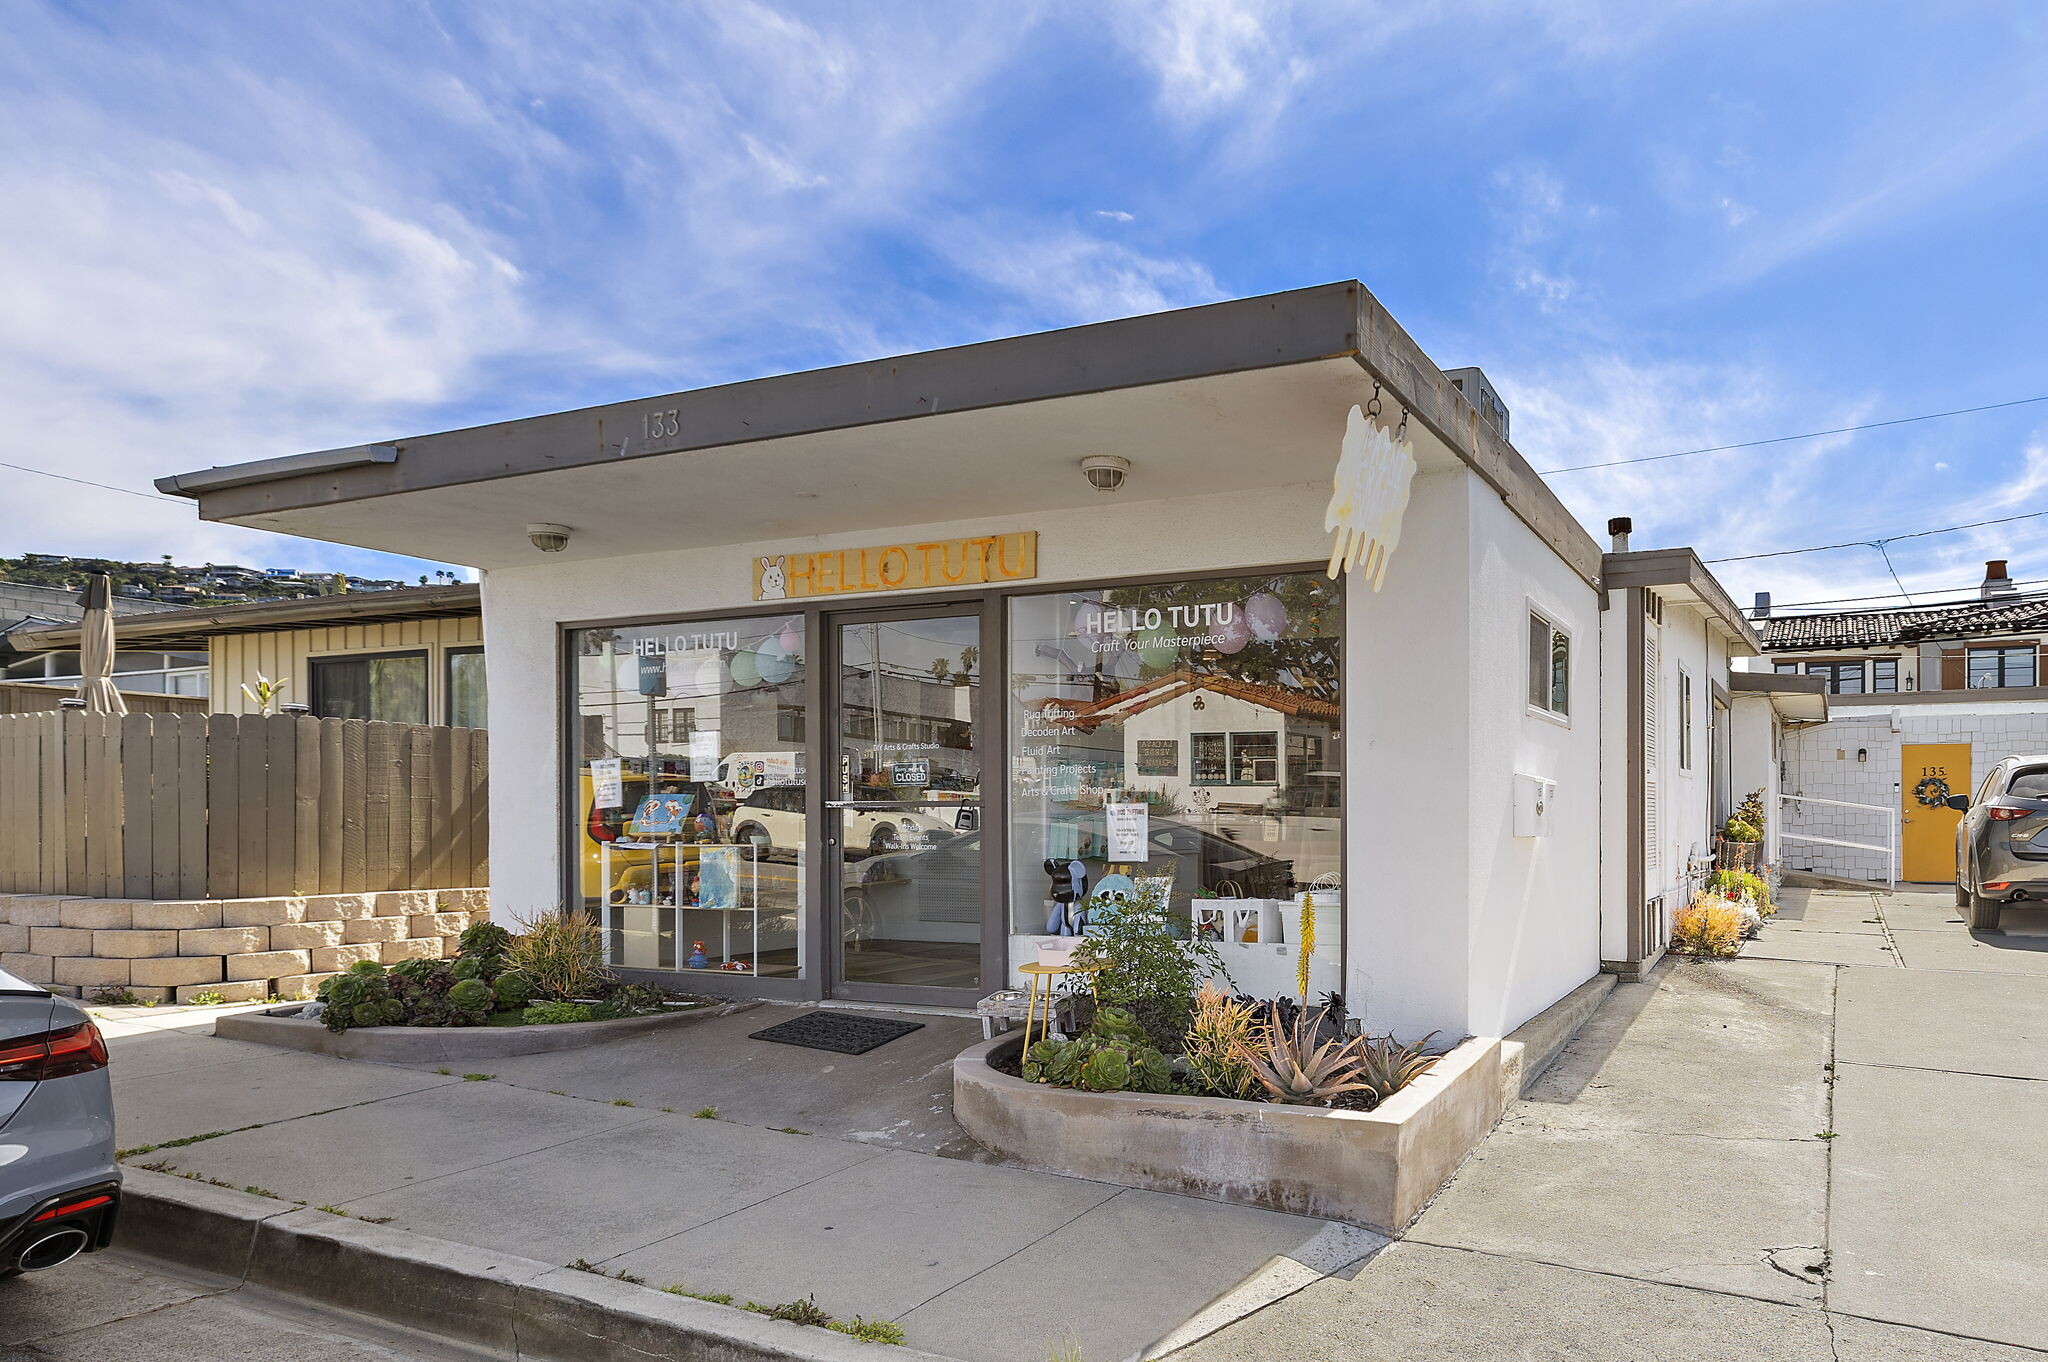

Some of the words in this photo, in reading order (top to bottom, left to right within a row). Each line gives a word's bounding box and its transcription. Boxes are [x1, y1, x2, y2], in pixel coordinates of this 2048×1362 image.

[641, 409, 680, 440] 133
[788, 546, 908, 596] HELLO
[916, 534, 1026, 584] TUTU
[1086, 607, 1161, 634] HELLO
[1167, 602, 1234, 628] TUTU
[632, 635, 687, 656] HELLO
[691, 631, 738, 652] TUTU
[1091, 640, 1120, 653] Craft
[1124, 638, 1150, 652] Your
[1152, 633, 1226, 649] Masterpiece
[1023, 709, 1041, 720] Rug
[1044, 708, 1075, 720] Tufting
[1021, 727, 1060, 737] Decoden
[1061, 726, 1076, 736] Art
[920, 742, 940, 750] Studio
[1021, 746, 1044, 756] Fluid
[1046, 745, 1061, 755] Art
[1021, 766, 1058, 776] Painting
[1060, 764, 1097, 776] Projects
[1921, 766, 1945, 776] 135
[895, 773, 926, 782] CLOSED
[1021, 788, 1040, 797] Arts
[1041, 786, 1049, 796] &
[1050, 784, 1078, 795] Crafts
[1079, 784, 1104, 796] Shop
[910, 842, 938, 850] Welcome
